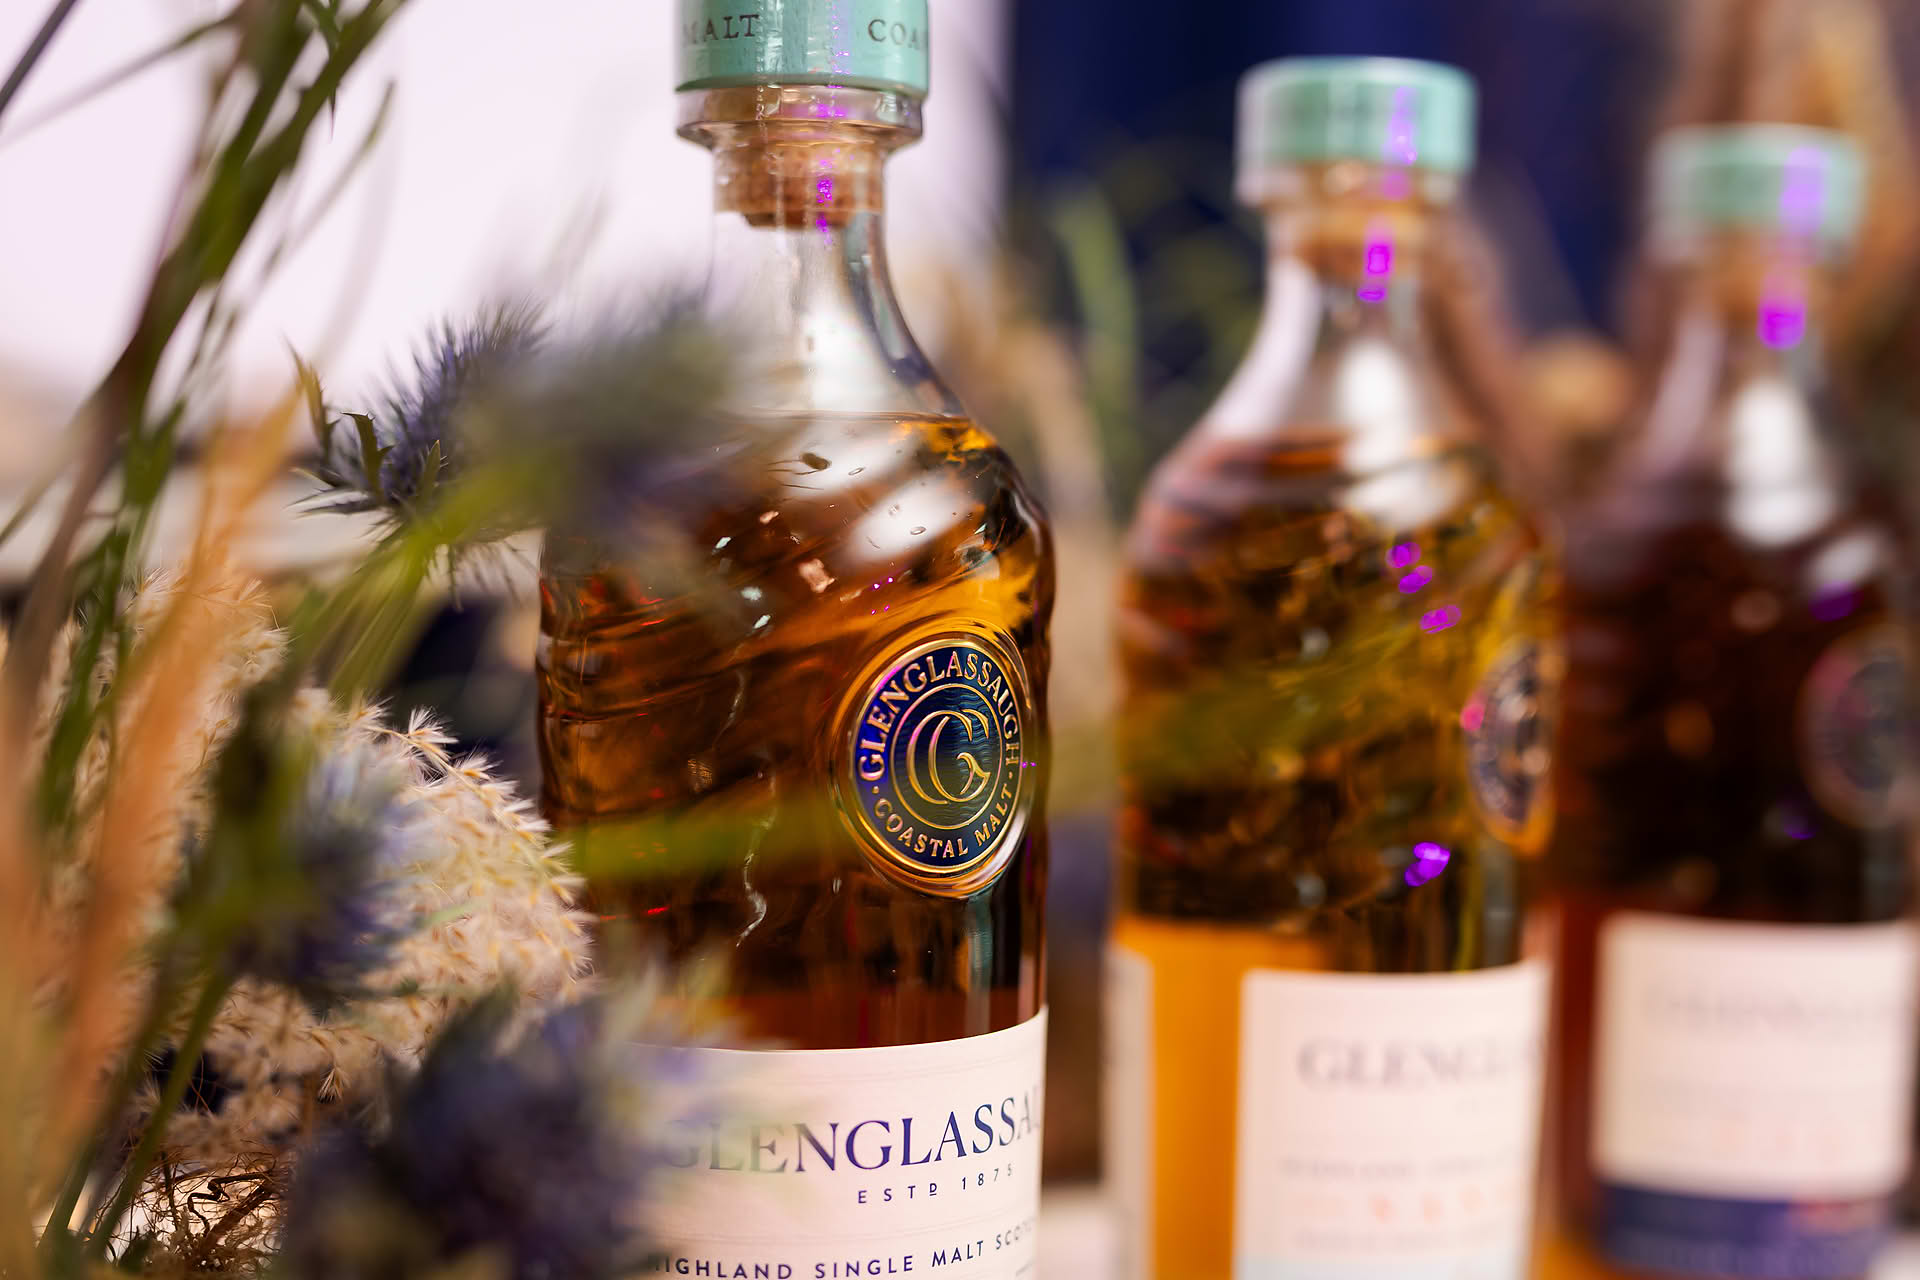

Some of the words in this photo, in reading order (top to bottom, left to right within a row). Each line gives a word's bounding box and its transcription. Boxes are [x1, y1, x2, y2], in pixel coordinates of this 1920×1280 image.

[858, 650, 1020, 782] GLENGLASSAUGH
[874, 797, 969, 858] COASTAL
[975, 782, 1016, 847] MALT
[961, 1163, 1013, 1191] 1875
[815, 1254, 914, 1279] SINGLE
[931, 1240, 984, 1268] MALT
